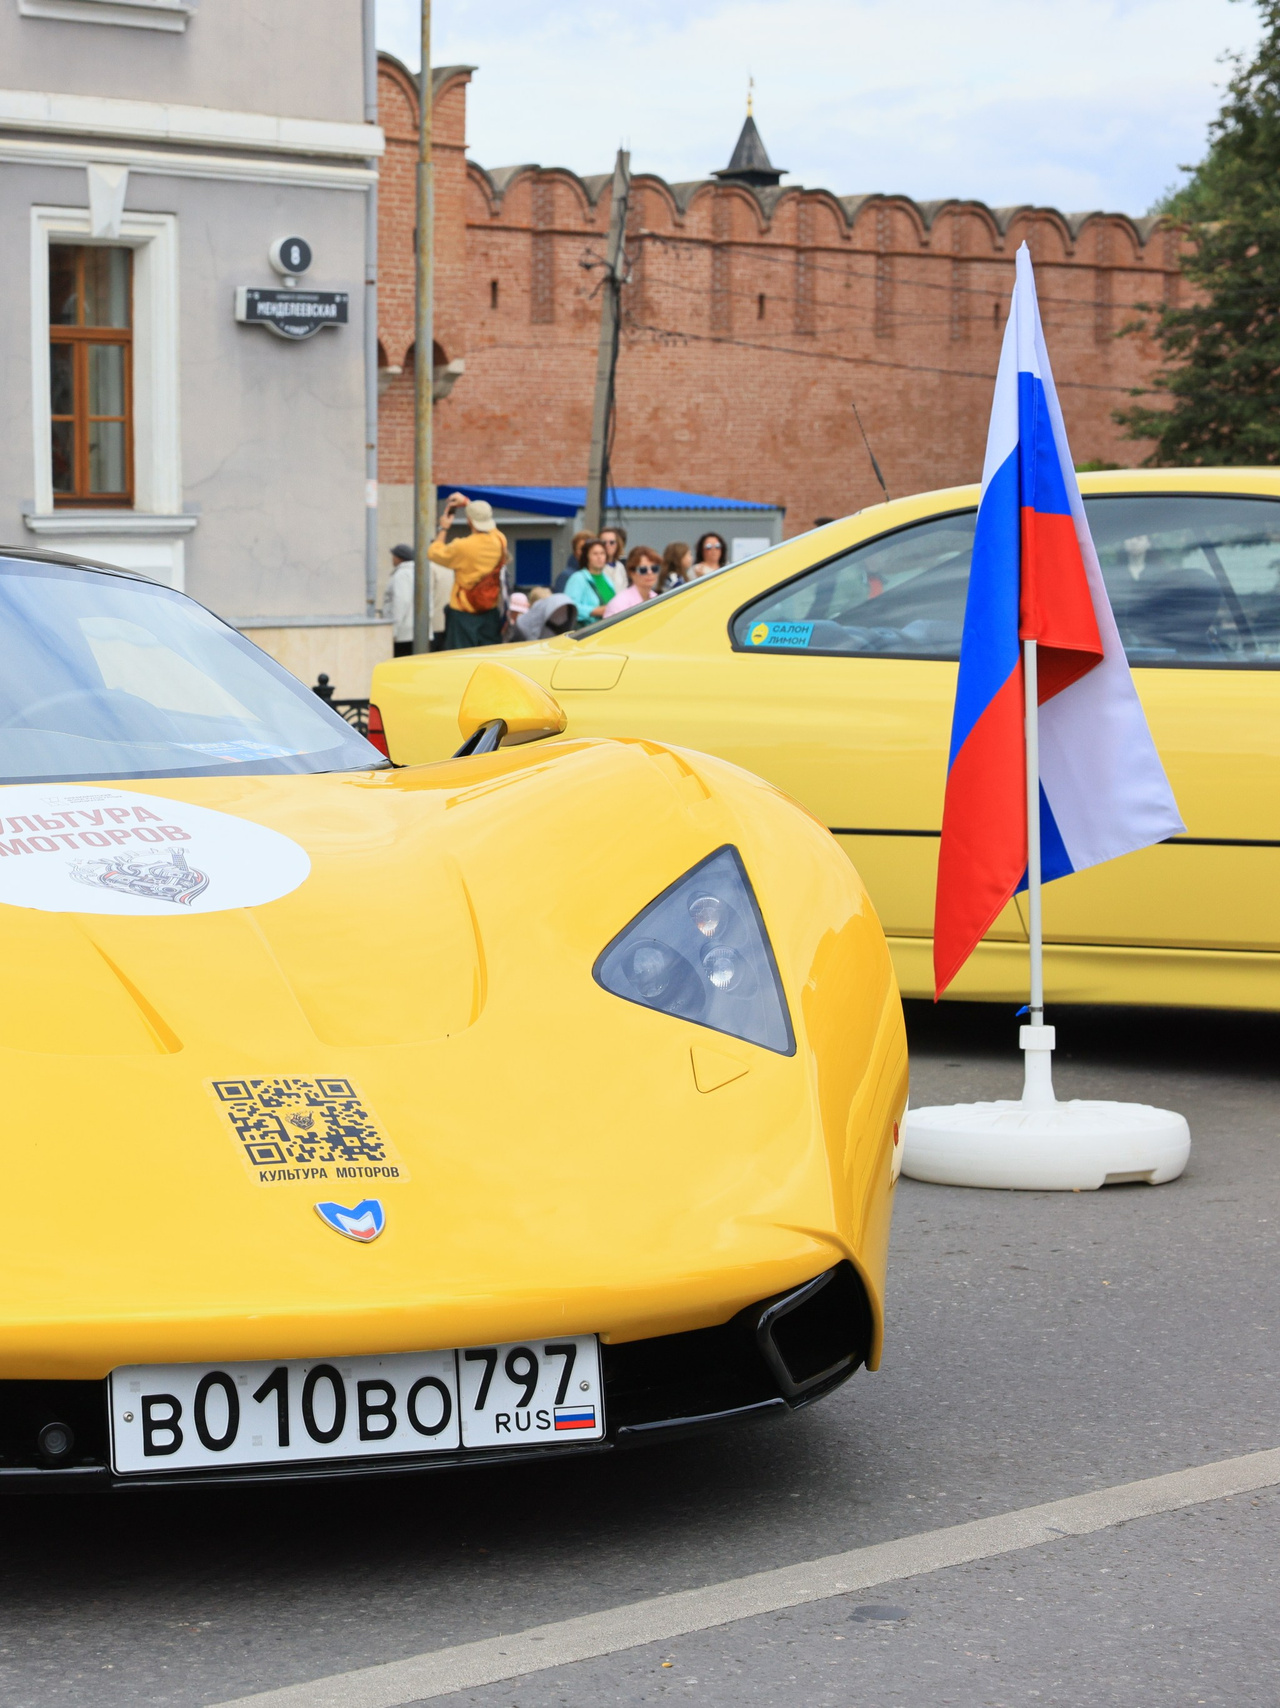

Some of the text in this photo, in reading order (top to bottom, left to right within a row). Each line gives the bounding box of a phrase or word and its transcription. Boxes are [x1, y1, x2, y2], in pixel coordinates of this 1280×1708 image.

[256, 301, 337, 318] МЕНДЕЛЕЕВСКАЯ
[772, 625, 809, 633] САЛОН
[768, 636, 806, 645] ЛИМОН
[259, 1166, 400, 1182] КУЛЬТУРА МОТОРОВ
[464, 1344, 577, 1411] 797
[495, 1410, 552, 1434] RUS
